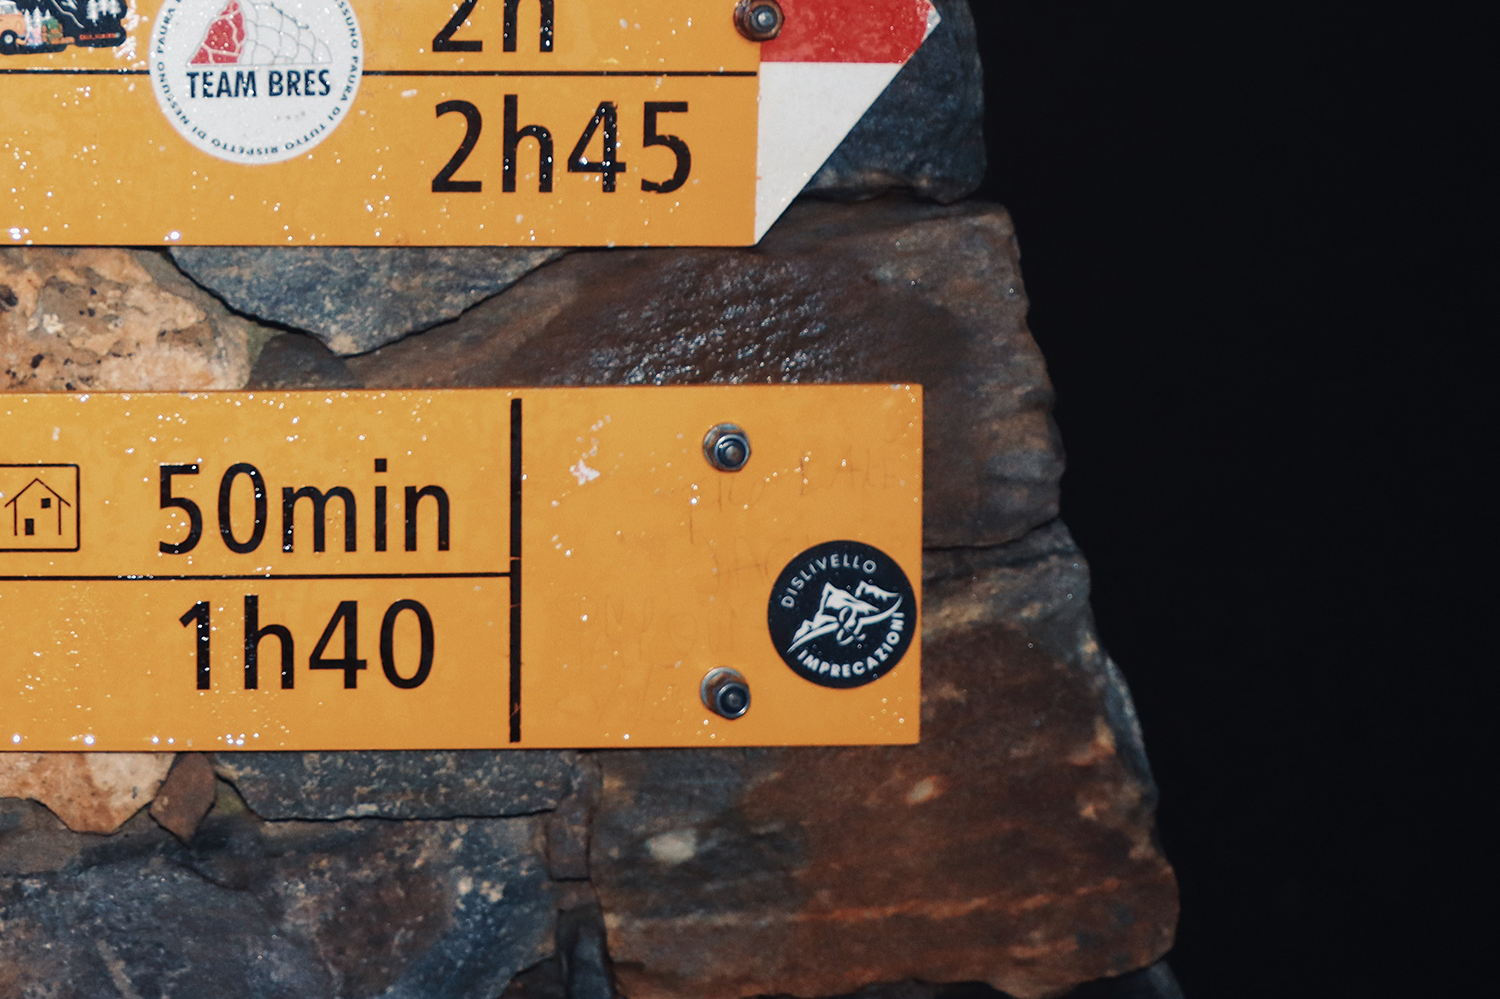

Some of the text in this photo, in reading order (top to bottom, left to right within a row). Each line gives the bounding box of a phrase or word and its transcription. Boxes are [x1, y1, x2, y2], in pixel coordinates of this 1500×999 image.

[156, 7, 177, 55] PAURA
[185, 68, 332, 99] TEAM BRES
[431, 93, 692, 194] 2h45
[157, 457, 451, 556] 50min
[780, 553, 878, 609] DISLIVELLO
[177, 594, 436, 691] 1h40
[796, 611, 906, 678] IMPRECAZIONI
